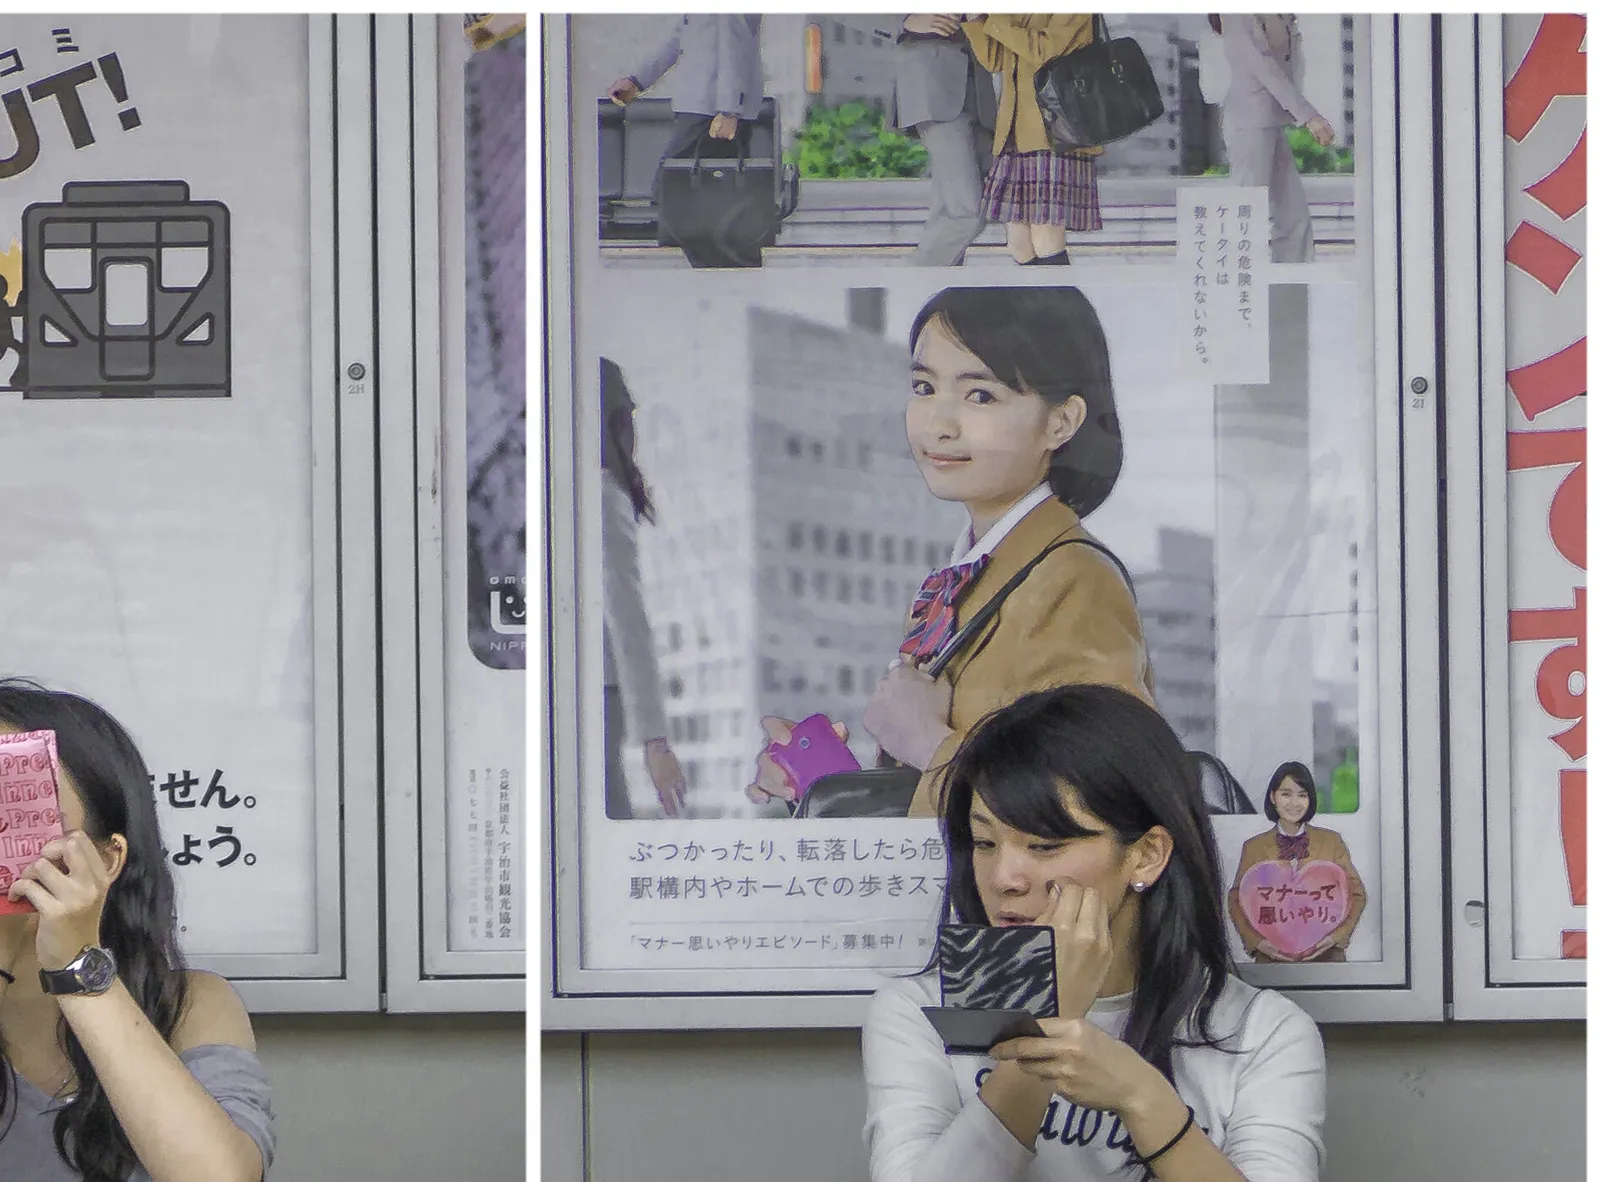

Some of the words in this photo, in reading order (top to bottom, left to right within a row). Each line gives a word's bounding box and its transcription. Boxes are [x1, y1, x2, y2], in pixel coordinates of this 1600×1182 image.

[1237, 204, 1253, 328] 周りの危険まで、
[1193, 205, 1209, 364] 教えてくれないから。
[6, 808, 61, 830] Pre
[629, 837, 945, 862] ぶつかったり、転落したら危
[1257, 884, 1337, 903] マナーって
[1257, 905, 1338, 926] 思いやり。
